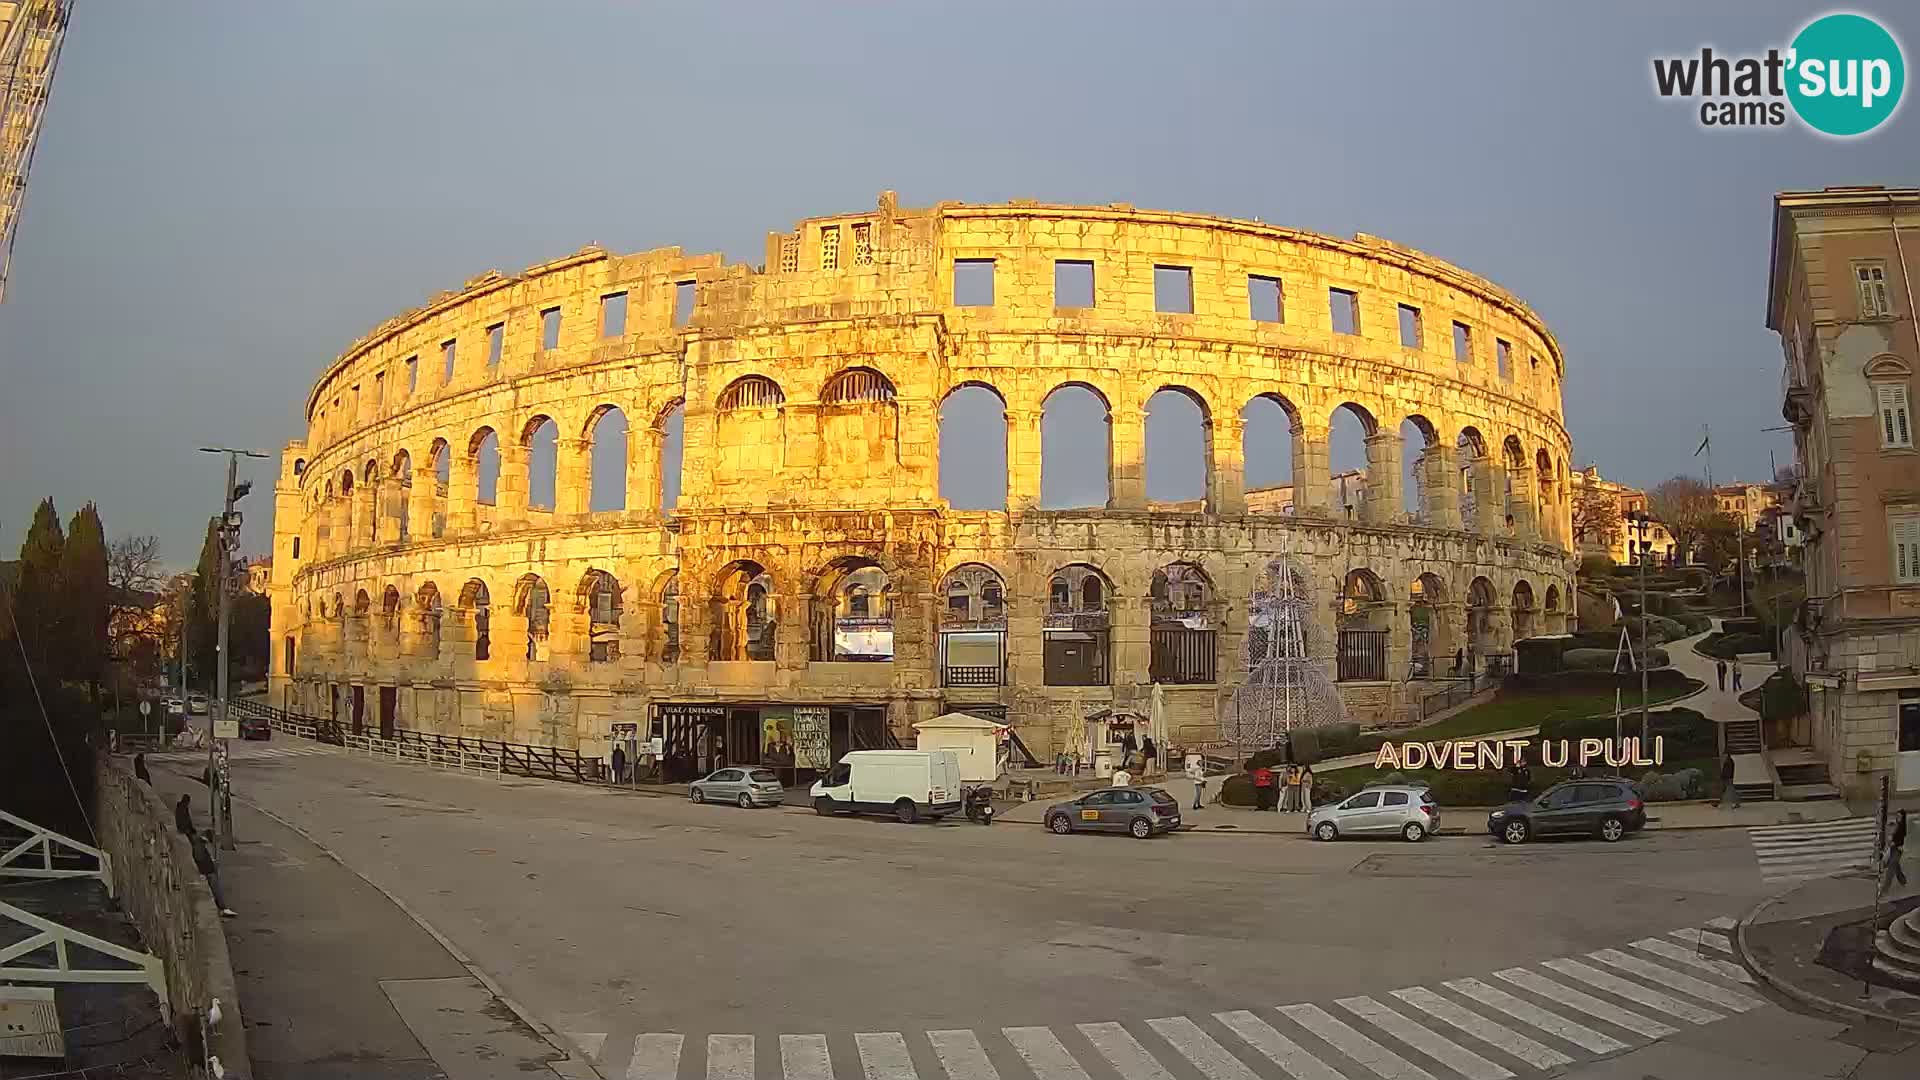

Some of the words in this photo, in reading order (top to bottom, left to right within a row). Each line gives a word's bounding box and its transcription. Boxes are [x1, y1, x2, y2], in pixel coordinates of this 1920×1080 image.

[688, 707, 725, 715] ENTRANCE
[1374, 740, 1530, 770] ADVENT
[1542, 739, 1569, 768] U
[1580, 735, 1663, 768] PULI
